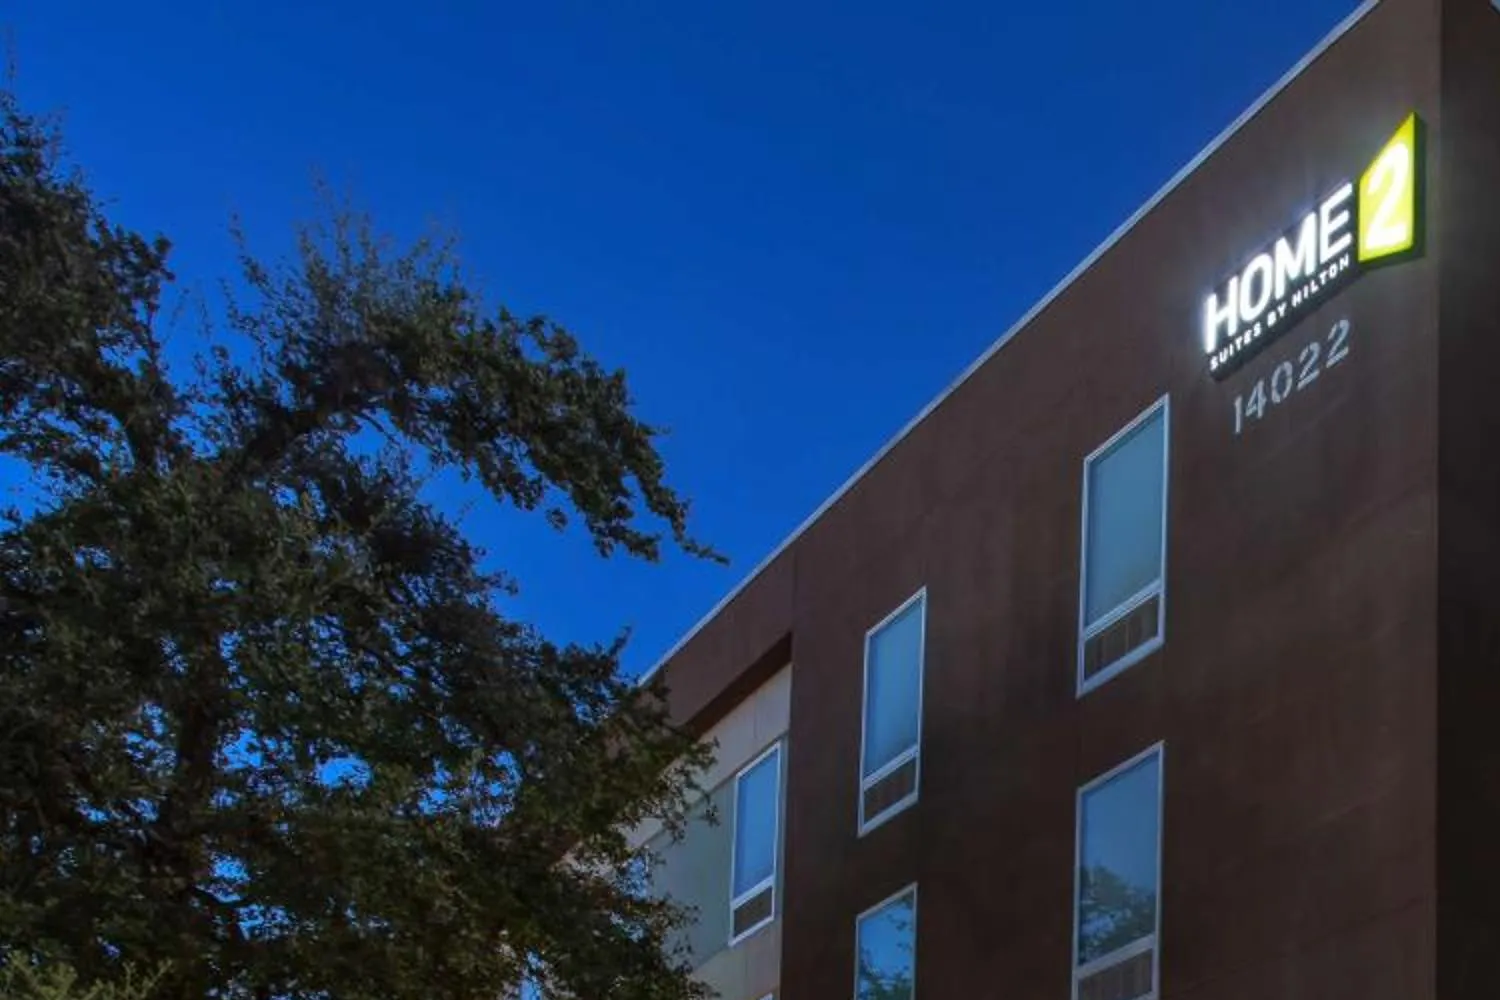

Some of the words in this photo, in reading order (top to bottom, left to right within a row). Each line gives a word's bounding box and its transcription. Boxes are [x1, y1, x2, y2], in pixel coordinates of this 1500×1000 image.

[1206, 183, 1352, 353] HOME
[1366, 142, 1410, 251] 2
[1210, 323, 1262, 371] SUITES
[1267, 303, 1288, 329] BY
[1291, 254, 1350, 306] HILTON
[1233, 319, 1351, 435] 14022
